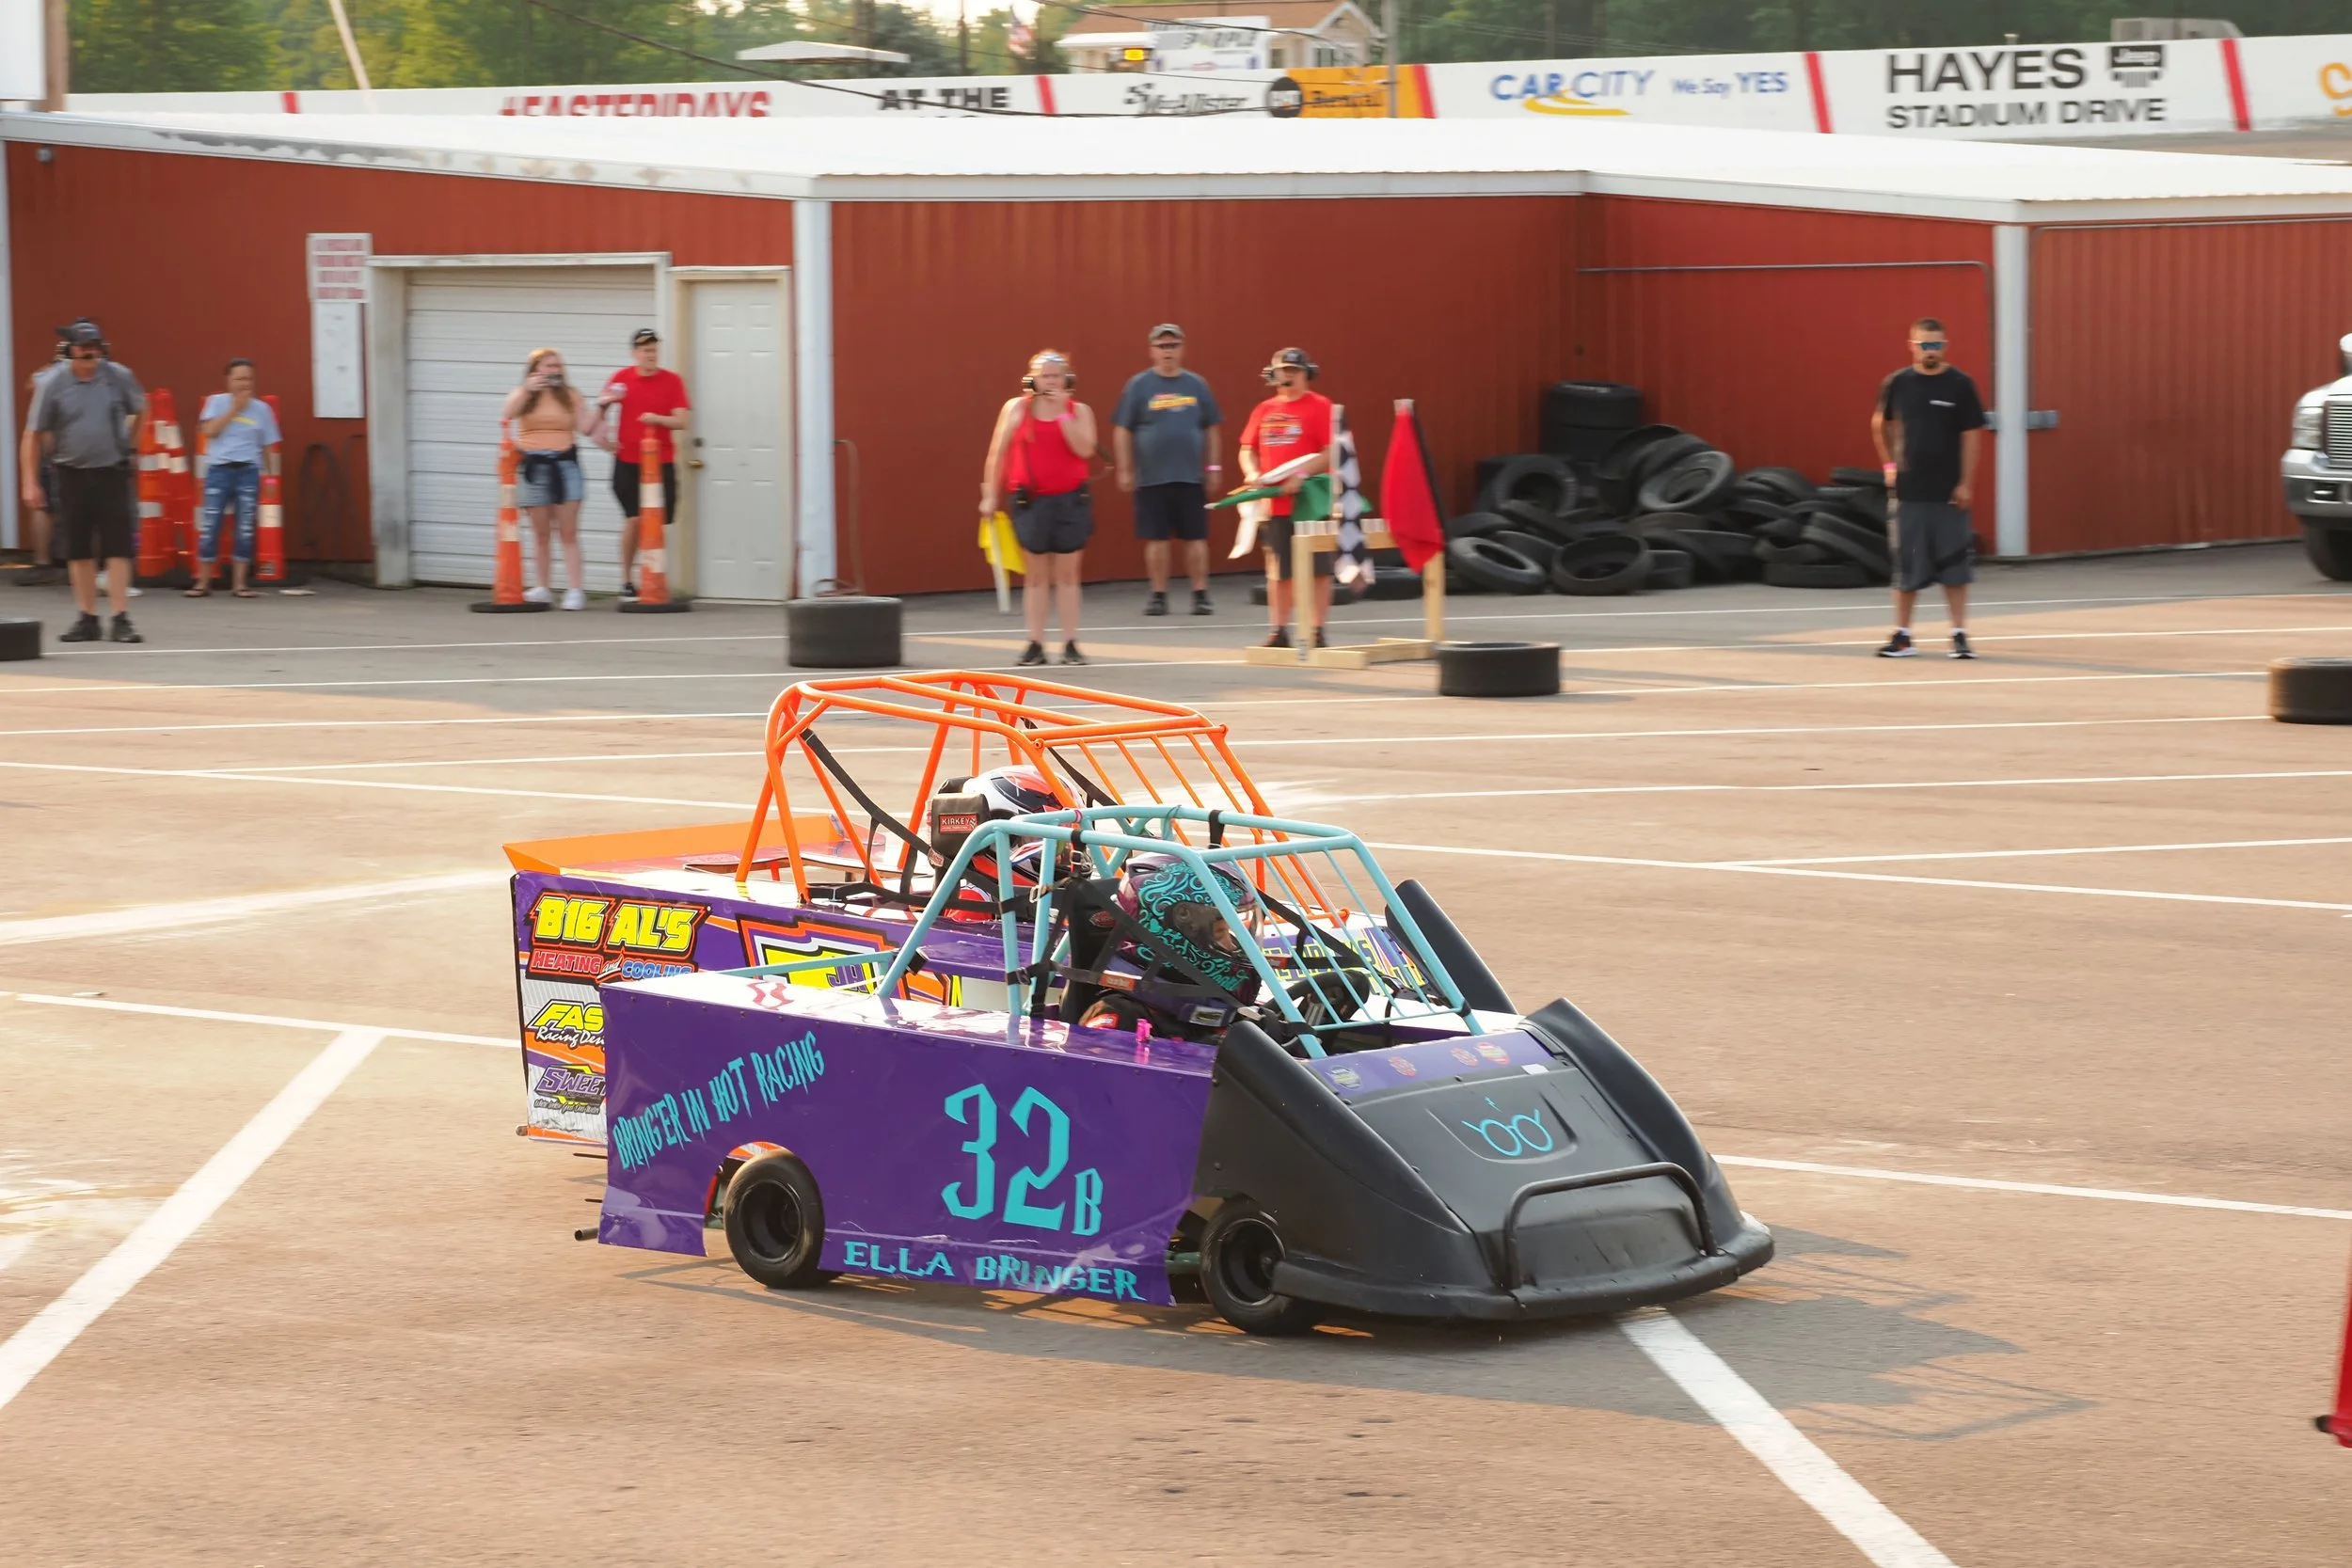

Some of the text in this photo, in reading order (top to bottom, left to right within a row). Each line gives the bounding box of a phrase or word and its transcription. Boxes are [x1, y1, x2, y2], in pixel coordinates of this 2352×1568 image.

[1489, 70, 1656, 101] CAR CITY
[1735, 71, 1789, 94] YES
[1884, 48, 2088, 93] HAYES
[877, 87, 1010, 110] AT THE
[1885, 97, 2167, 130] STADIUM DRIVE
[942, 817, 970, 826] KIRKEY
[534, 896, 701, 952] BIG AL'S
[532, 950, 602, 974] HEATING
[535, 1025, 580, 1048] Racing
[535, 1067, 606, 1097] SWEE
[681, 1088, 712, 1144] IN
[707, 1056, 753, 1122] HOT
[750, 1030, 825, 1111] RACING
[844, 1241, 1147, 1302] ELLA BRINGER
